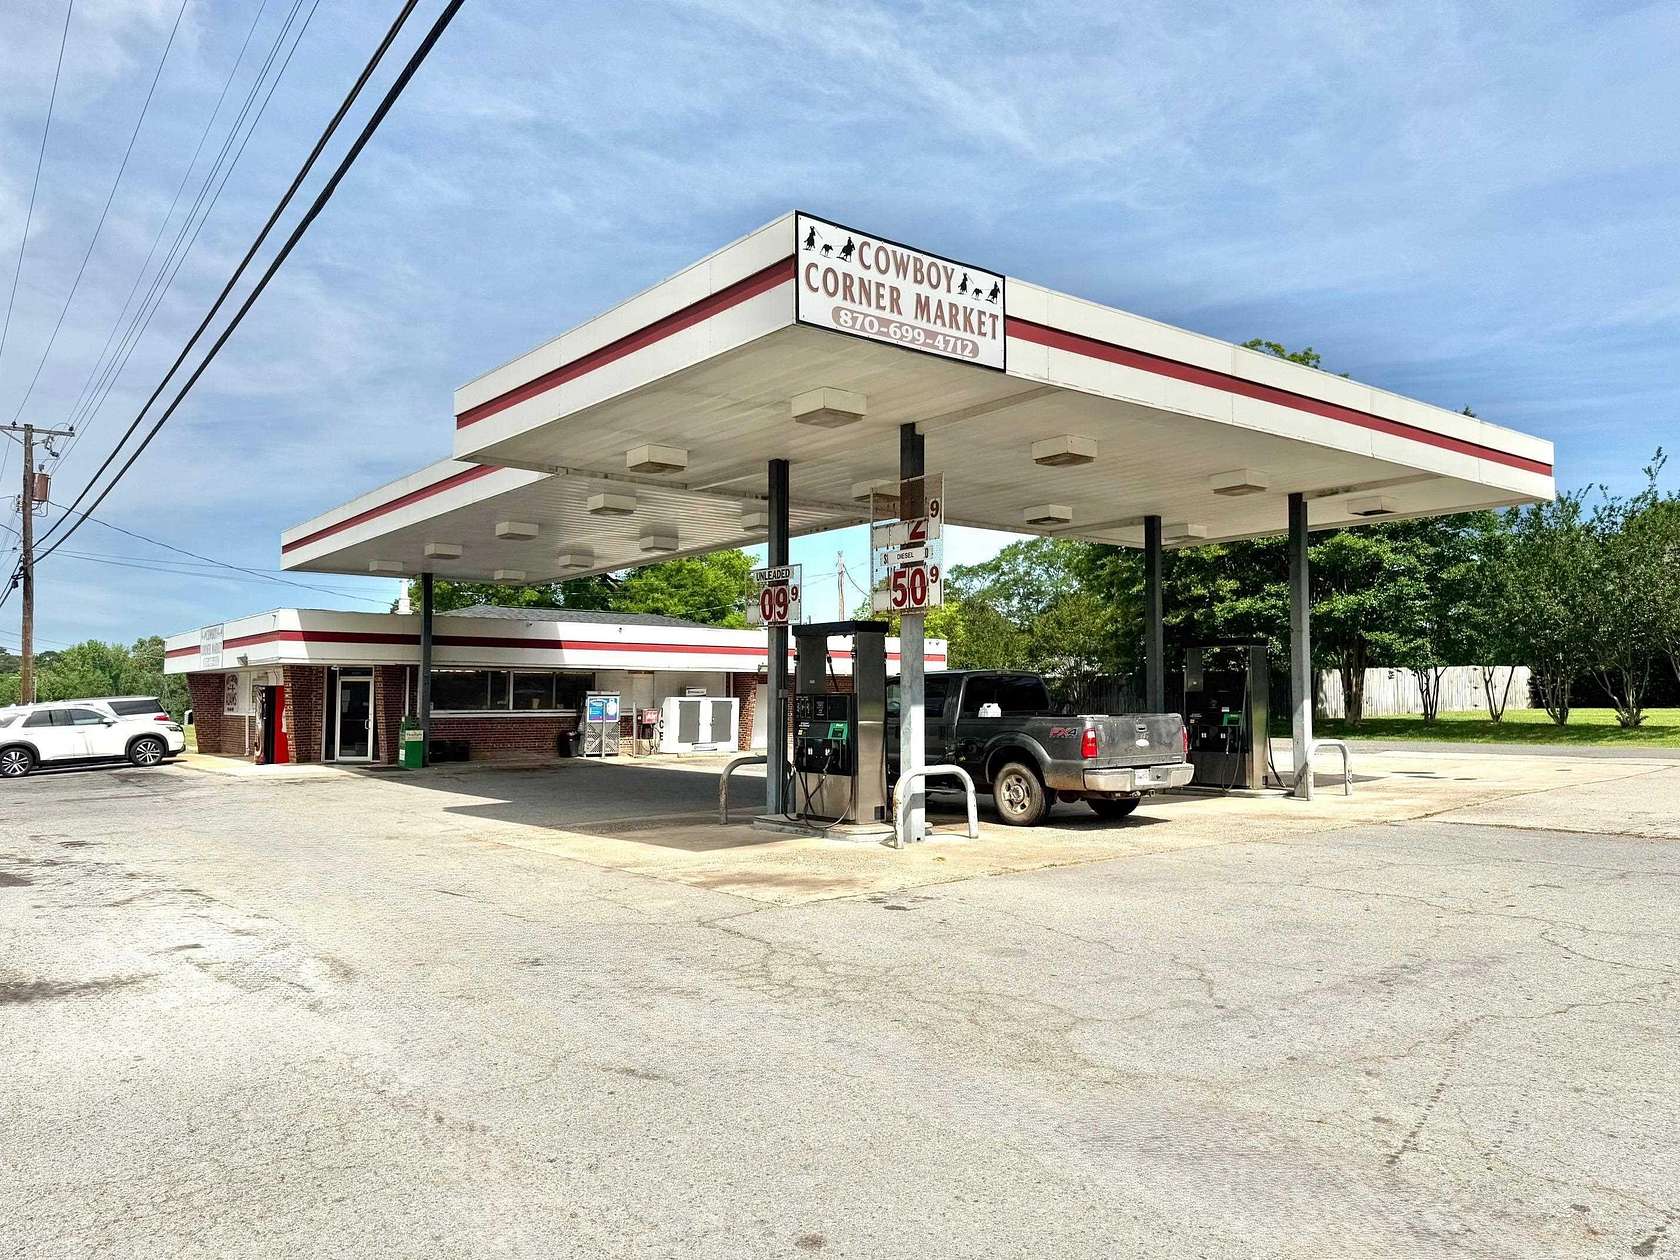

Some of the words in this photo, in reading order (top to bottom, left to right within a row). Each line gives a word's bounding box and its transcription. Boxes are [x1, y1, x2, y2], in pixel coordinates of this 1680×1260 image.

[858, 240, 955, 294] COWBOY
[804, 262, 903, 316] CORNER
[914, 292, 999, 341] MARKET
[839, 309, 973, 358] 870-699-4712
[756, 568, 791, 582] UNLEADED
[896, 552, 914, 560] DIESEL
[760, 587, 789, 621] 09
[790, 585, 799, 602] 9
[892, 567, 927, 608] 50
[929, 565, 939, 584] 9
